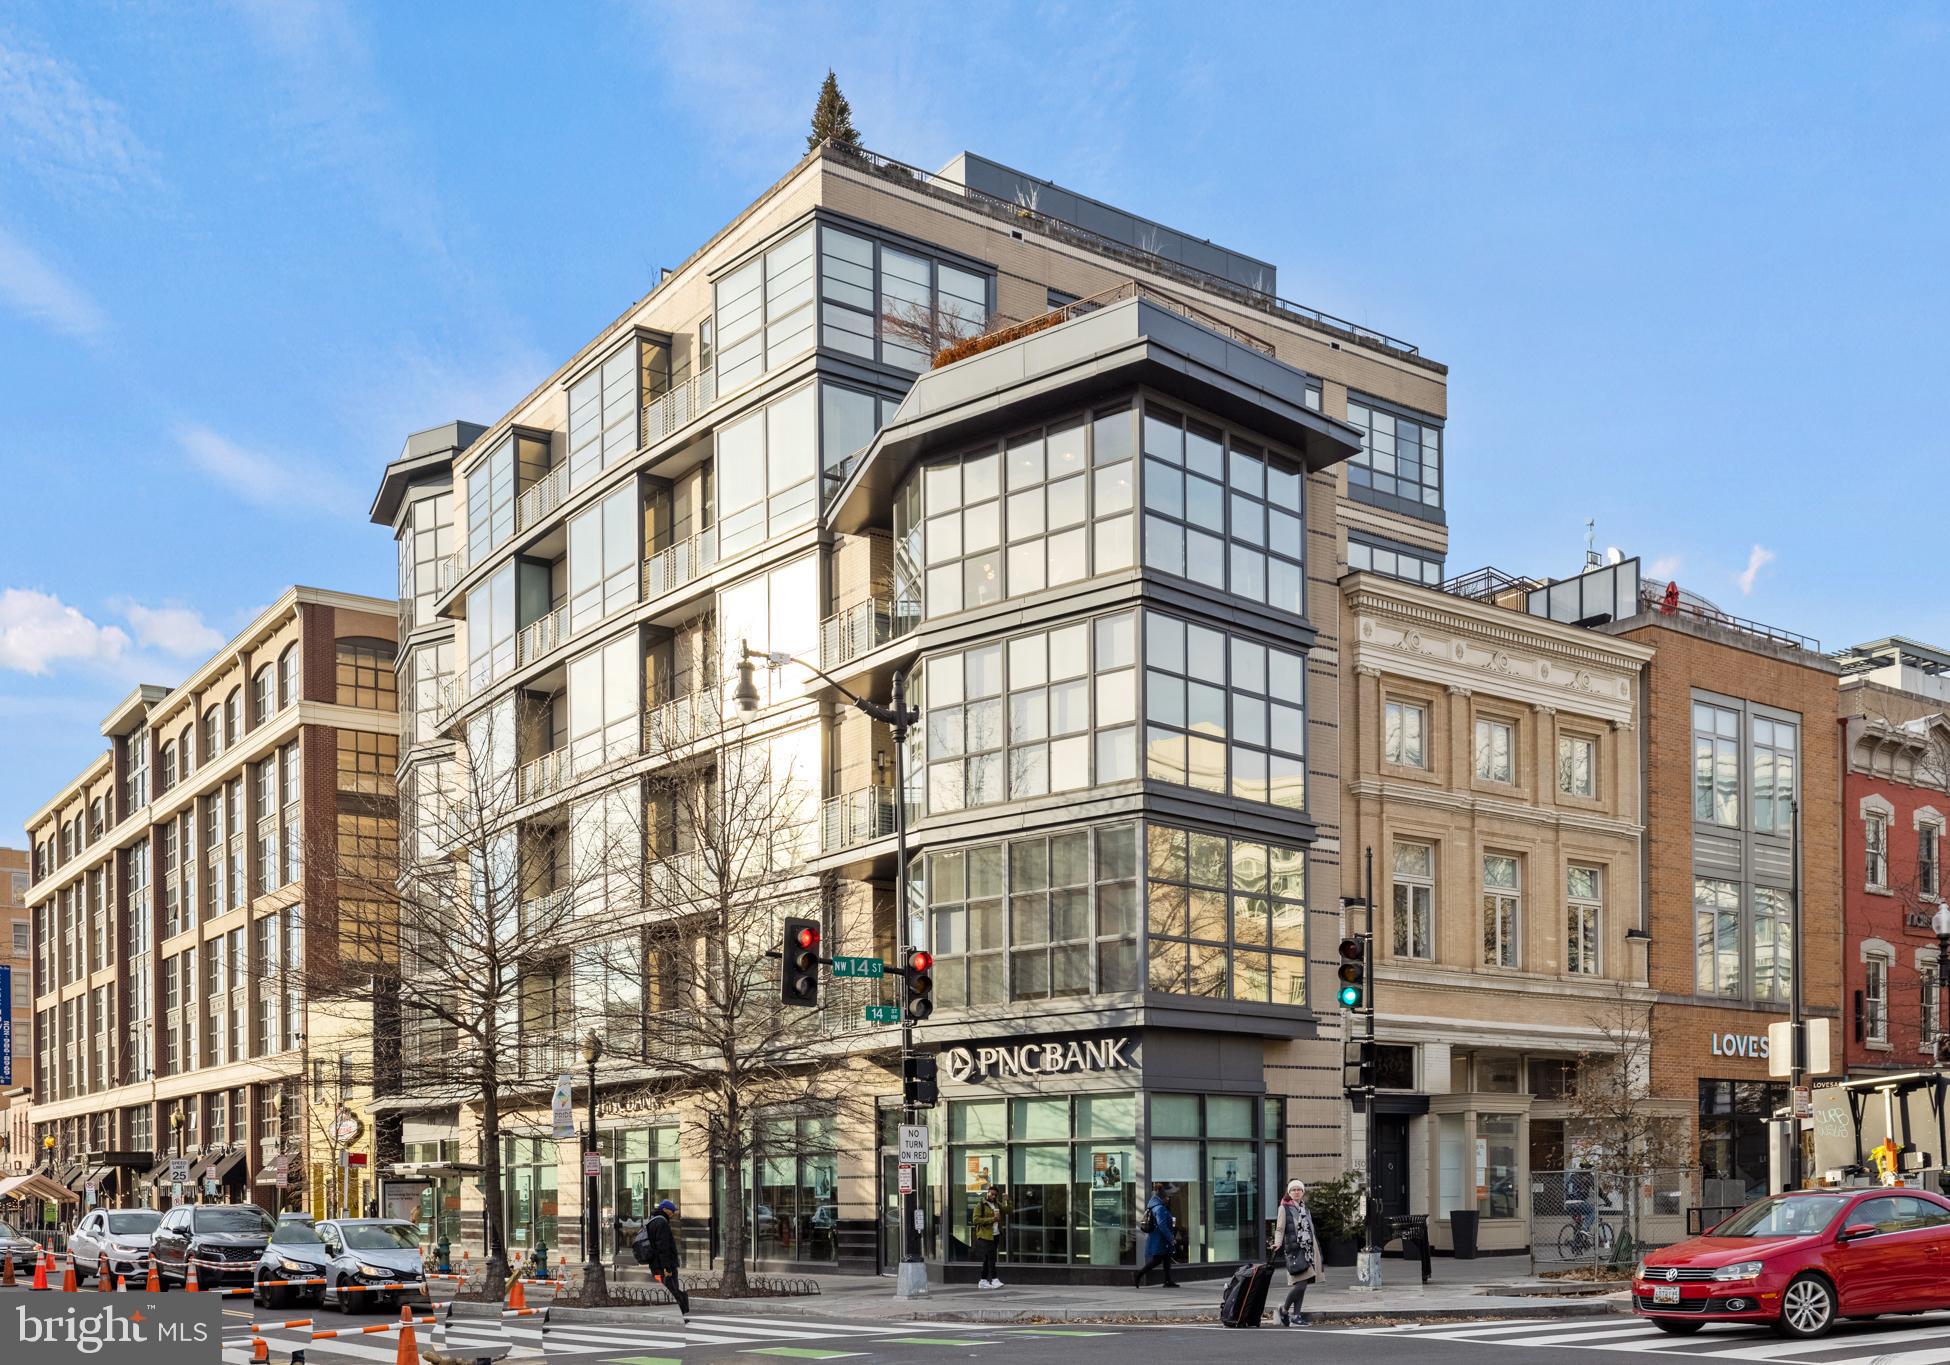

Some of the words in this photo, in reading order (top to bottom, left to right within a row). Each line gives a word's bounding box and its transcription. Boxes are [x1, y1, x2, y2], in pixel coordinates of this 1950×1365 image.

[834, 961, 846, 971] NW
[850, 959, 869, 976] 14
[872, 963, 883, 973] ST
[871, 1007, 883, 1019] 14
[1712, 1032, 1770, 1059] LOVES
[908, 1129, 919, 1138] NO
[905, 1140, 924, 1149] TURN
[901, 1151, 911, 1160] ON
[913, 1151, 927, 1160] RED
[172, 1171, 187, 1181] 25
